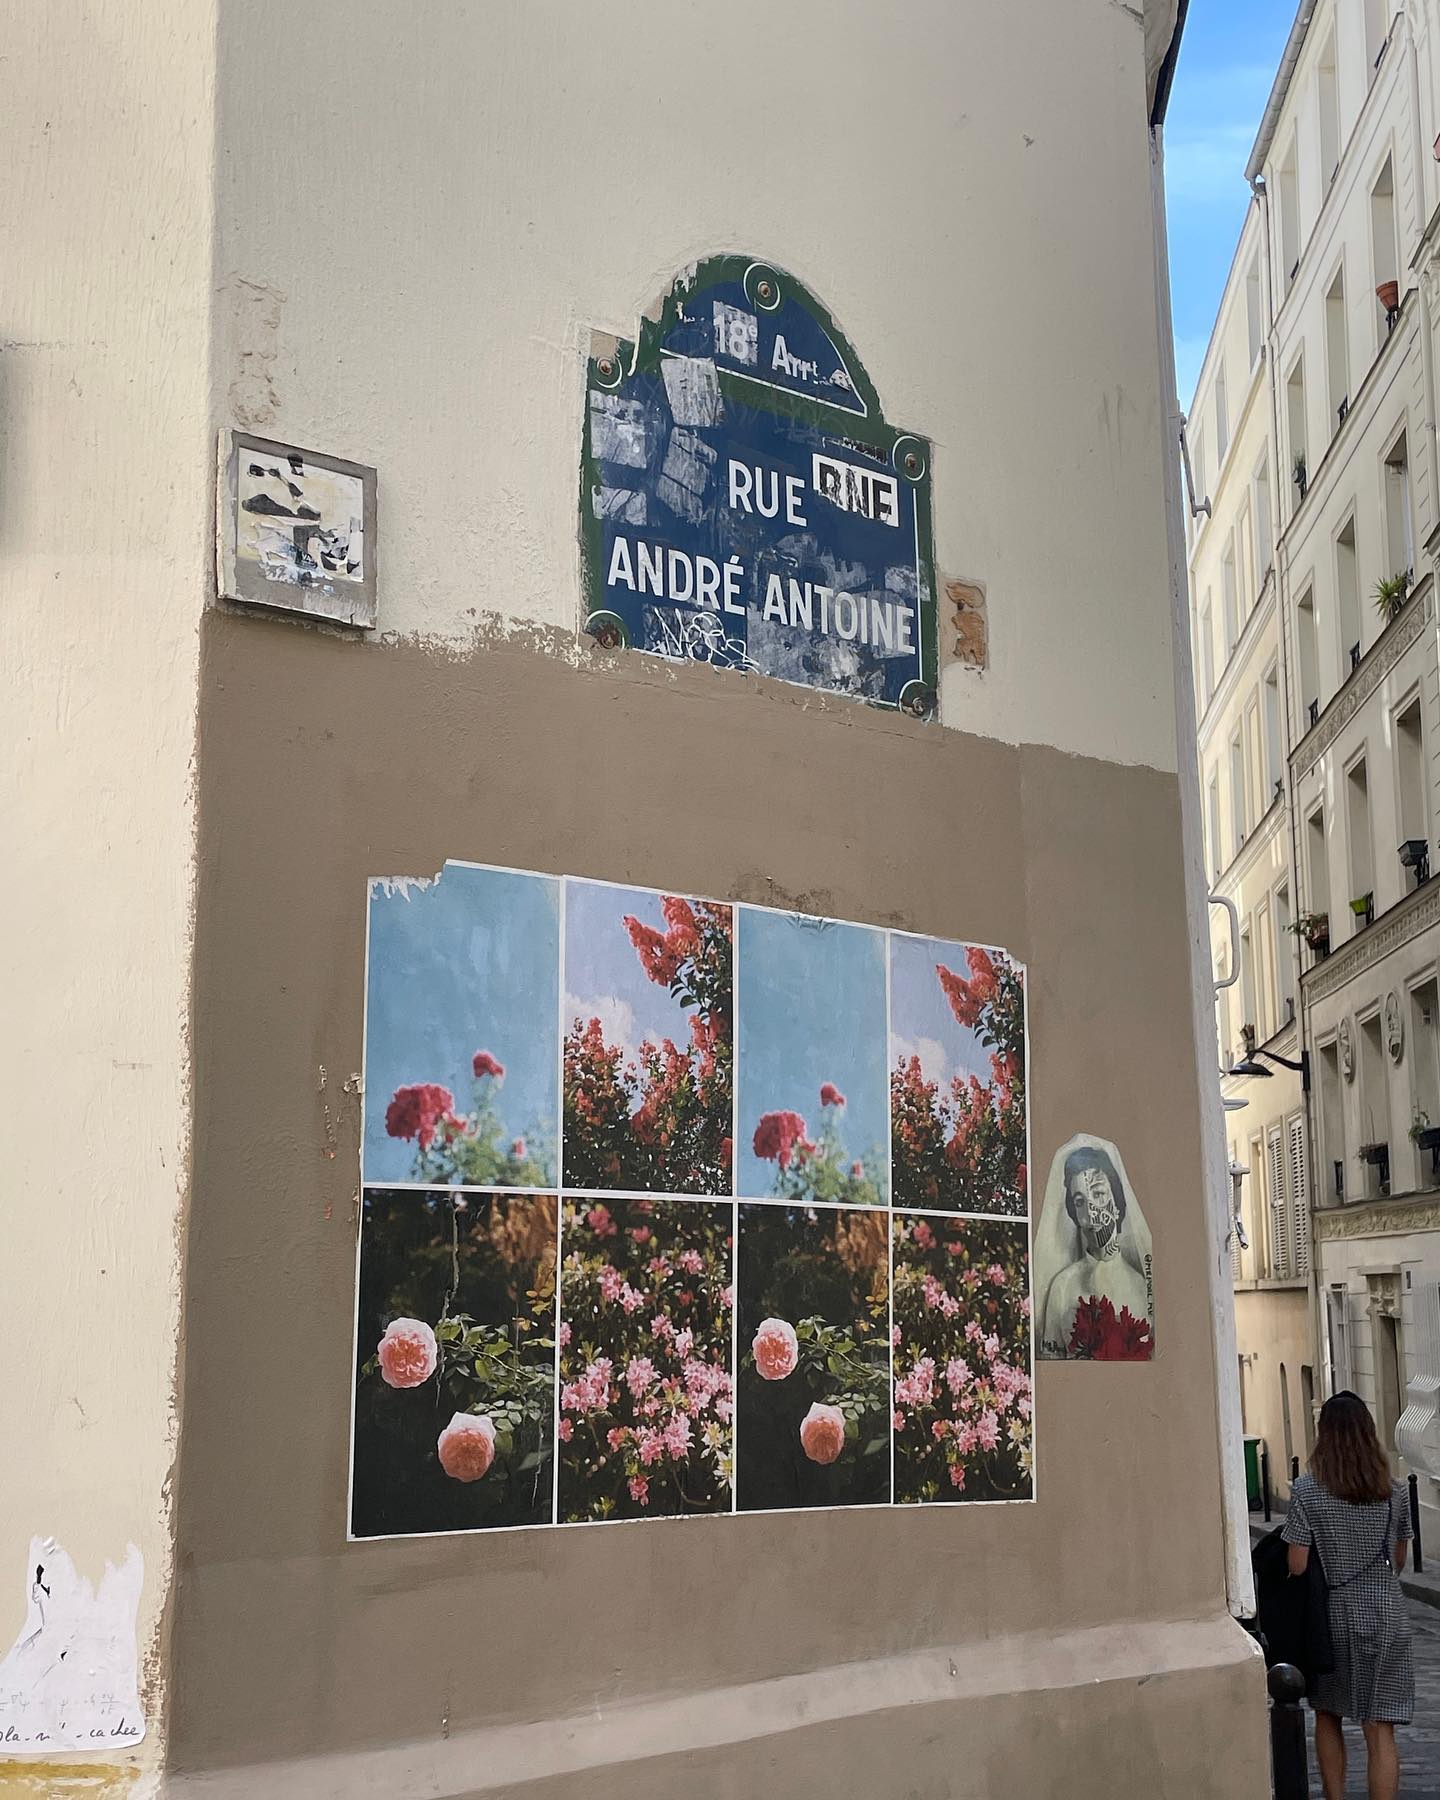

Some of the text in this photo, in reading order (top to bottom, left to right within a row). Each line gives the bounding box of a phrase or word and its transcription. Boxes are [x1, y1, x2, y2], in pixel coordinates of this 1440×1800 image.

[728, 458, 808, 527] RUE
[607, 535, 746, 616] ANDRÉ
[762, 573, 916, 655] ANTOINE
